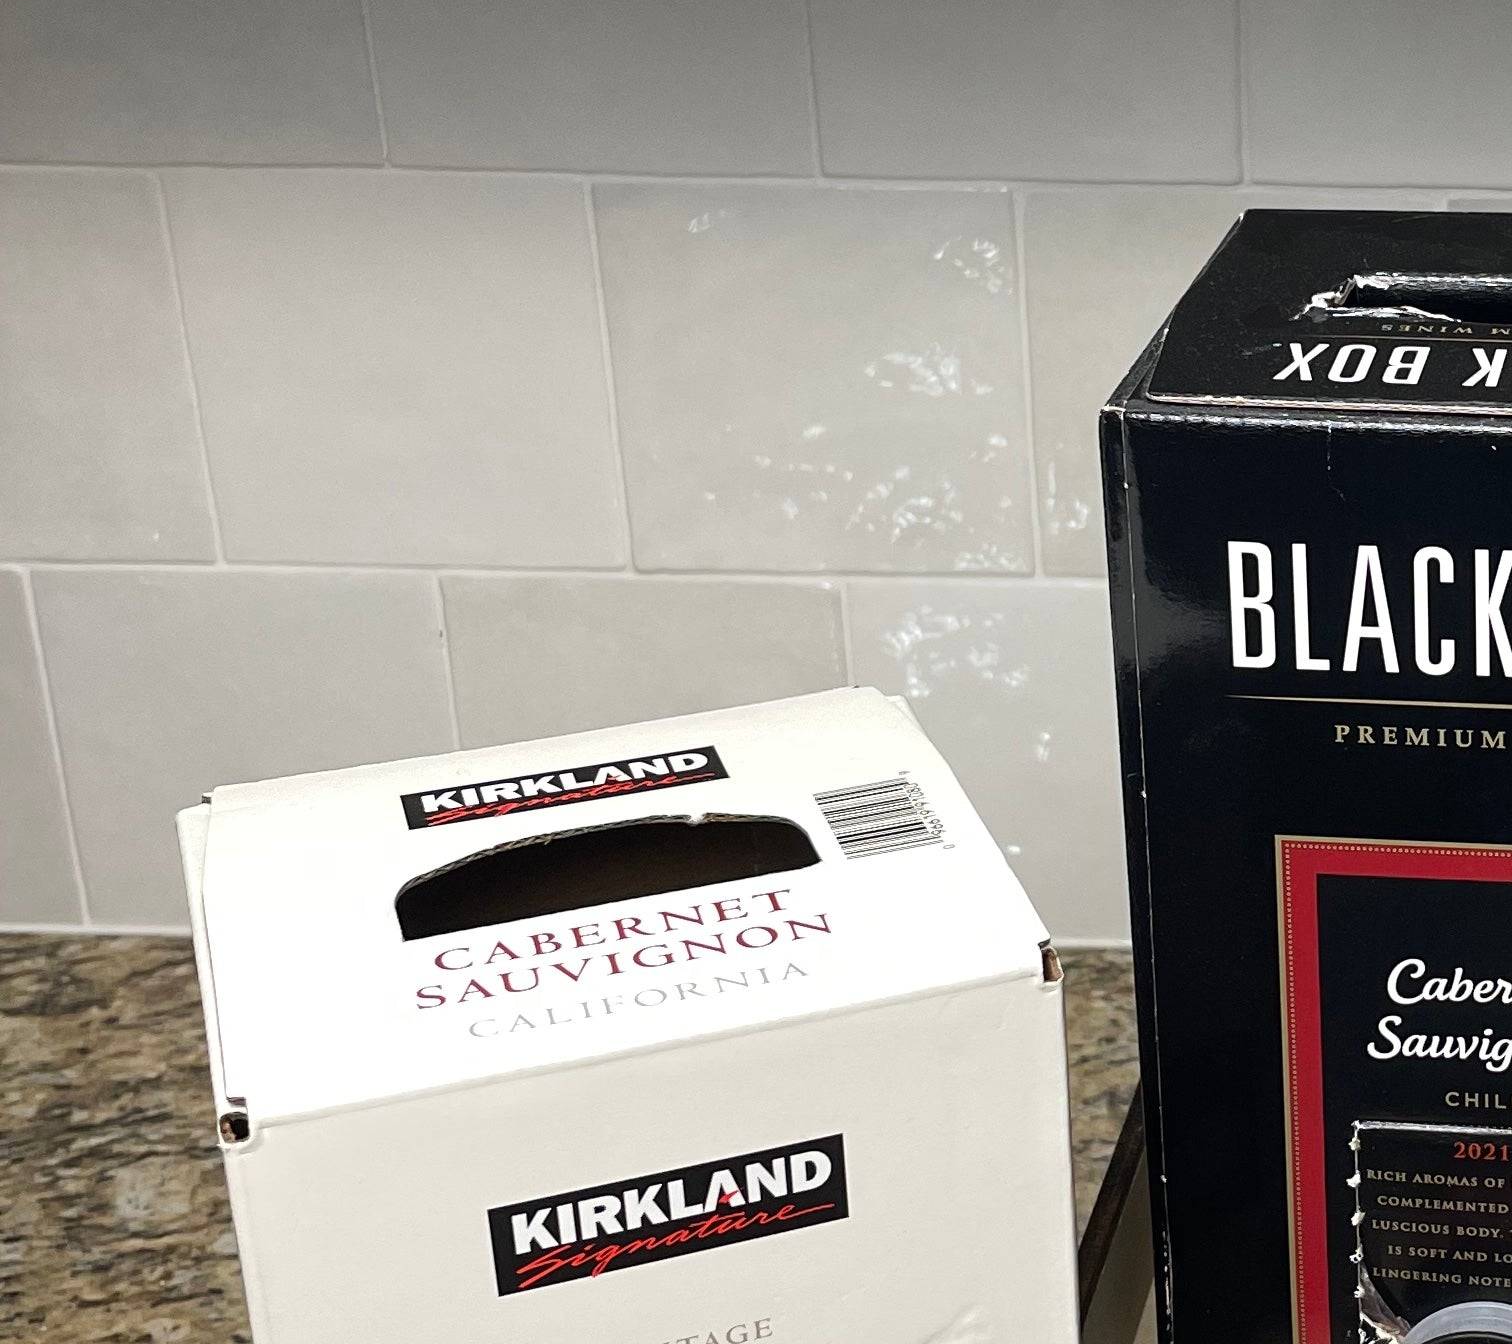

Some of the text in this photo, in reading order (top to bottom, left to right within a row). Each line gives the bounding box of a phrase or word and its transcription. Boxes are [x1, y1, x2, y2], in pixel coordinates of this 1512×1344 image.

[1380, 323, 1473, 336] WINES
[1273, 342, 1431, 385] BOX
[1334, 723, 1507, 750] PREMIUM
[420, 752, 708, 813] KIRKLAND
[434, 889, 791, 971] CABERNET
[416, 912, 833, 1009] SAUVIGNON
[468, 961, 809, 1038] CALIFORNIA
[1453, 1141, 1511, 1162] 2021
[1366, 1169, 1407, 1183] RICH
[1412, 1172, 1478, 1187] AROMAS
[1484, 1177, 1505, 1188] OF
[511, 1150, 832, 1255] KIRKLAND
[1376, 1195, 1509, 1214] COMPLEMENTED
[1372, 1219, 1450, 1235] LUSCIOUS
[516, 1202, 834, 1288] Signature
[1387, 1245, 1402, 1256] IS
[1408, 1246, 1448, 1259] SOFT
[1452, 1250, 1488, 1262] AND
[1373, 1267, 1462, 1284] LINGERING
